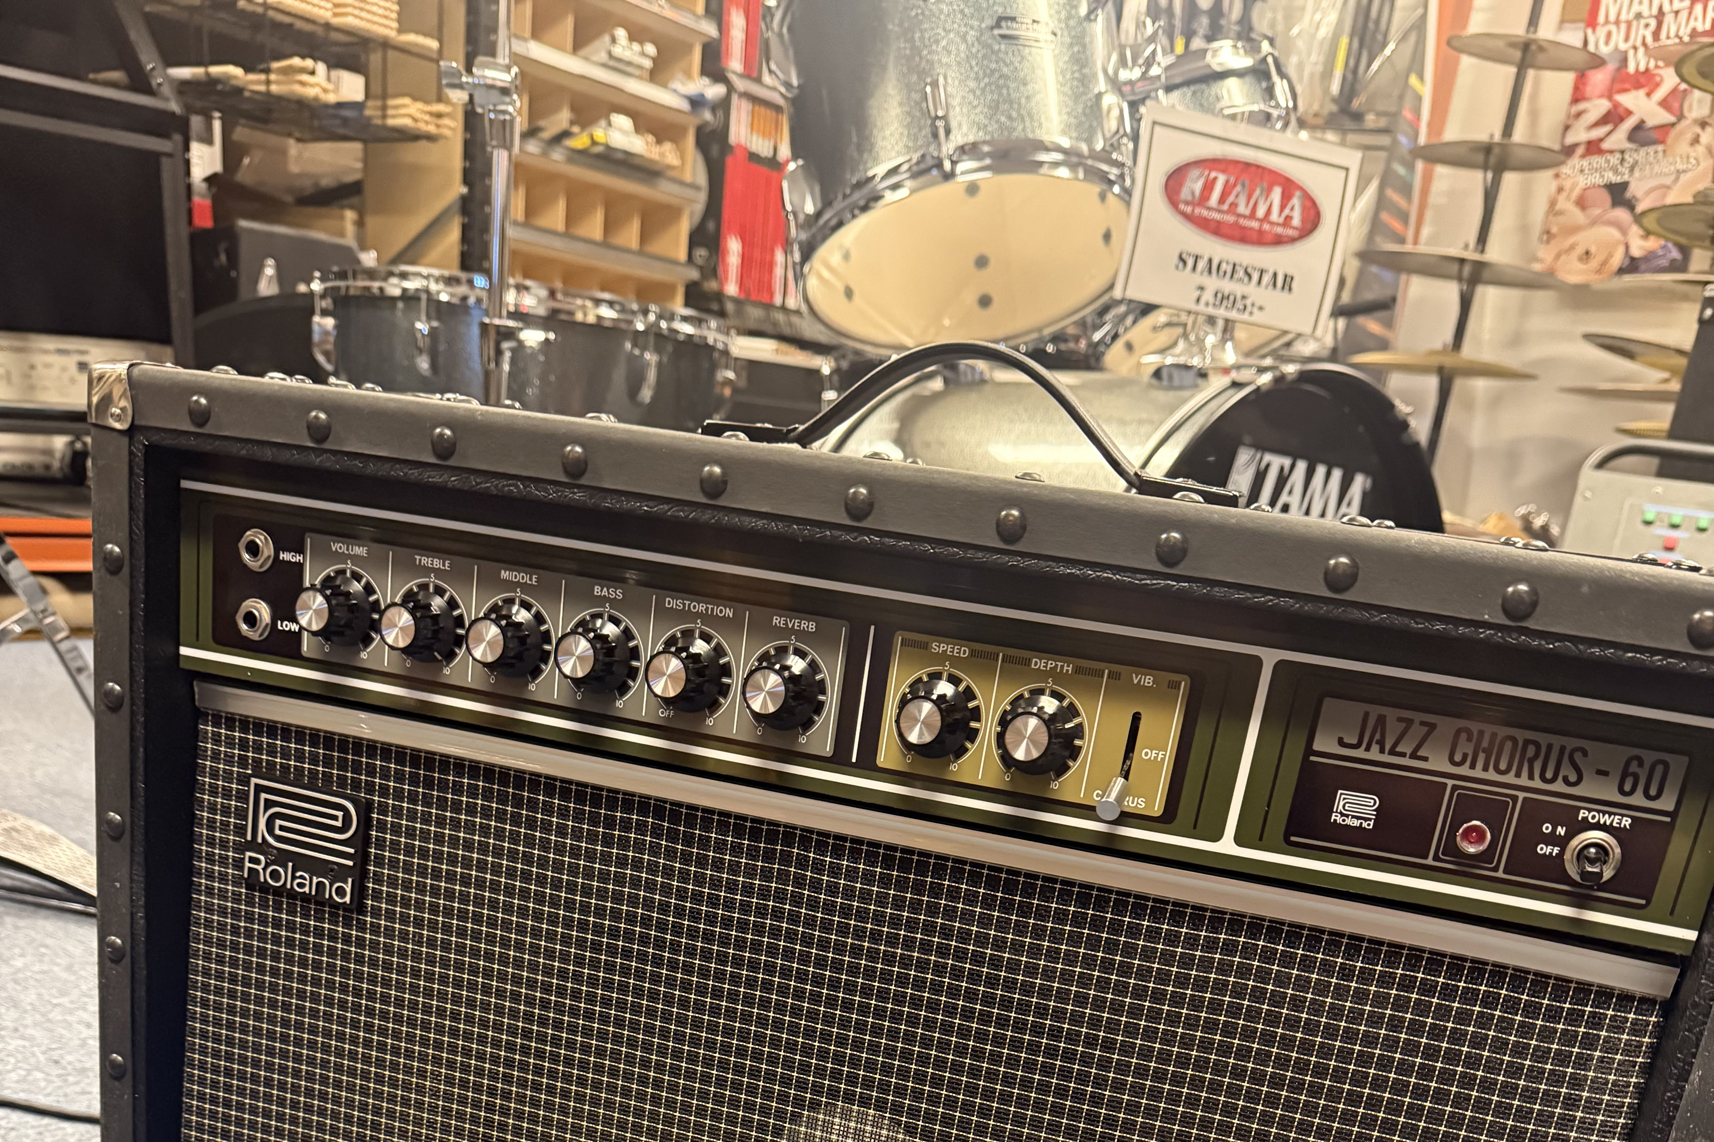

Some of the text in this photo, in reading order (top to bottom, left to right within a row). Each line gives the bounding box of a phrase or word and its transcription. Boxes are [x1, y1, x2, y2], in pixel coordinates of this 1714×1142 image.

[1586, 17, 1657, 53] YOUR
[1206, 171, 1305, 229] TAMA
[1175, 249, 1295, 295] STAGESTAR
[1258, 450, 1367, 521] TAMA
[330, 541, 369, 557] VOLUME
[279, 550, 304, 564] HIGH
[414, 555, 451, 570] TREBLE
[346, 559, 353, 568] 5
[429, 573, 436, 582] 5
[500, 569, 539, 585] MIDDLE
[515, 587, 522, 597] 5
[593, 585, 623, 600] BASS
[604, 602, 611, 612] 5
[665, 597, 734, 618] DISTORTION
[277, 619, 300, 633] LOW
[695, 618, 702, 628] 5
[772, 615, 817, 633] REVERB
[790, 634, 797, 645] 5
[324, 643, 331, 654] 0
[931, 642, 969, 658] SPEED
[359, 650, 369, 661] 10
[405, 658, 412, 669] 0
[943, 661, 950, 670] 5
[1031, 658, 1074, 675] DEPTH
[442, 666, 451, 676] 10
[489, 675, 496, 684] 0
[1046, 677, 1053, 687] 5
[1131, 673, 1157, 688] VIB.
[527, 682, 537, 692] 10
[576, 691, 583, 701] 0
[615, 699, 624, 709] 10
[658, 707, 675, 719] OFF
[705, 716, 715, 727] 10
[756, 726, 763, 736] 0
[1337, 710, 1438, 763] JAZZ
[797, 734, 808, 744] 10
[905, 754, 913, 763] 0
[1141, 748, 1166, 762] OFF
[949, 762, 959, 772] 10
[1003, 771, 1011, 782] 0
[1049, 780, 1060, 790] 10
[1093, 790, 1146, 808] CUS
[1330, 812, 1376, 830] Roland
[1578, 809, 1632, 830] POWER
[1542, 822, 1566, 837] ON
[1536, 843, 1561, 858] OFF
[243, 851, 353, 905] Roland
